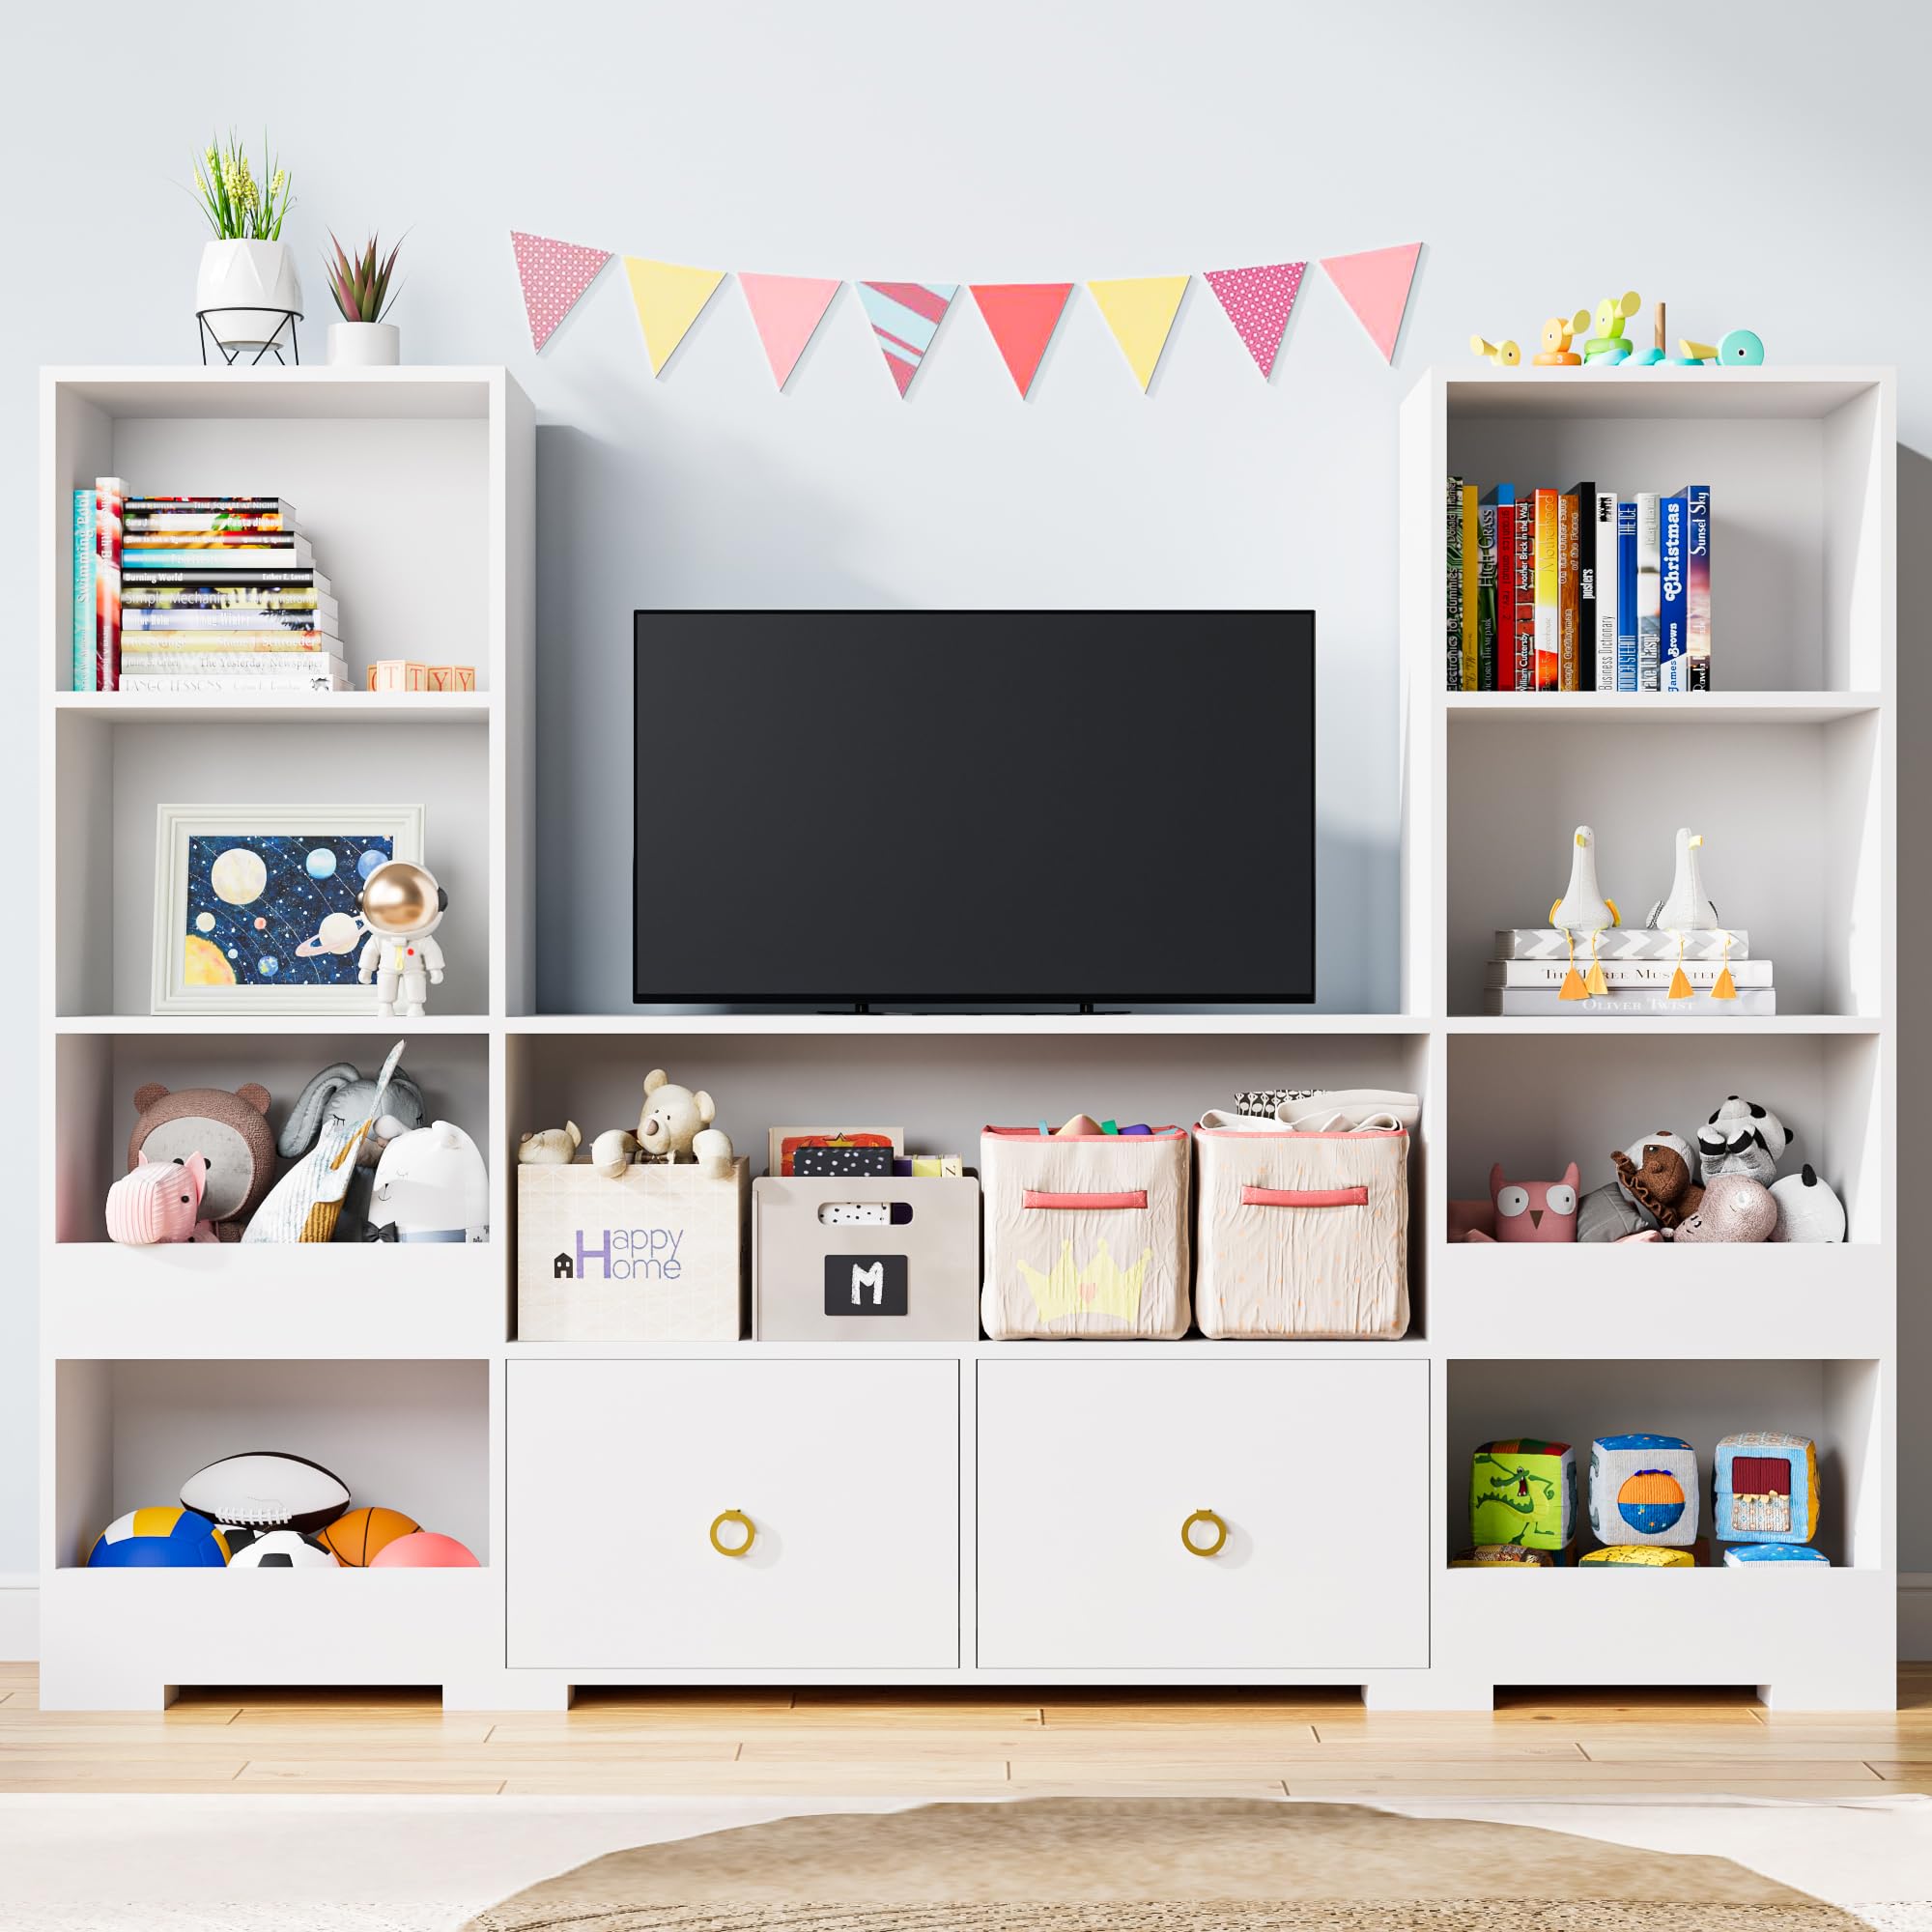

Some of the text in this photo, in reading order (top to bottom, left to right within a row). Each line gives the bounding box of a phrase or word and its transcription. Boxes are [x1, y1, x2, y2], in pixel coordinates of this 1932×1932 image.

[195, 501, 212, 510] TIME
[252, 501, 277, 510] NIGHT
[1520, 502, 1528, 519] Wall
[1448, 513, 1457, 542] Donald
[1502, 509, 1512, 551] graphics
[1520, 521, 1528, 532] the
[1538, 495, 1554, 572] Motherhood
[1619, 507, 1635, 535] THE ICE
[1689, 492, 1709, 556] Sunset Sky
[76, 495, 95, 604] Swimming Pool
[1478, 509, 1494, 587] HIGH GRASS
[1520, 541, 1528, 560] Brick
[1570, 512, 1578, 571] of the Fence
[1663, 503, 1683, 601] Christmas
[126, 573, 184, 584] Burning World
[1502, 554, 1512, 584] annual
[1520, 560, 1528, 590] Another
[1580, 568, 1596, 599] posters
[126, 592, 165, 608] Simple
[1448, 567, 1458, 613] dummies
[1598, 616, 1615, 691] Business Dictionary
[1639, 633, 1660, 659] Easy!
[1667, 622, 1680, 692] James Brown
[200, 657, 217, 668] The
[220, 657, 265, 670] Yesterday
[1447, 636, 1458, 691] Electronics
[1520, 632, 1529, 691] William Cuttersby
[1563, 663, 1574, 691] oseph
[1639, 670, 1658, 691] Take
[1576, 969, 1629, 980] TREE
[1582, 997, 1692, 1011] OLIVER TWIST
[851, 1261, 884, 1305] M
